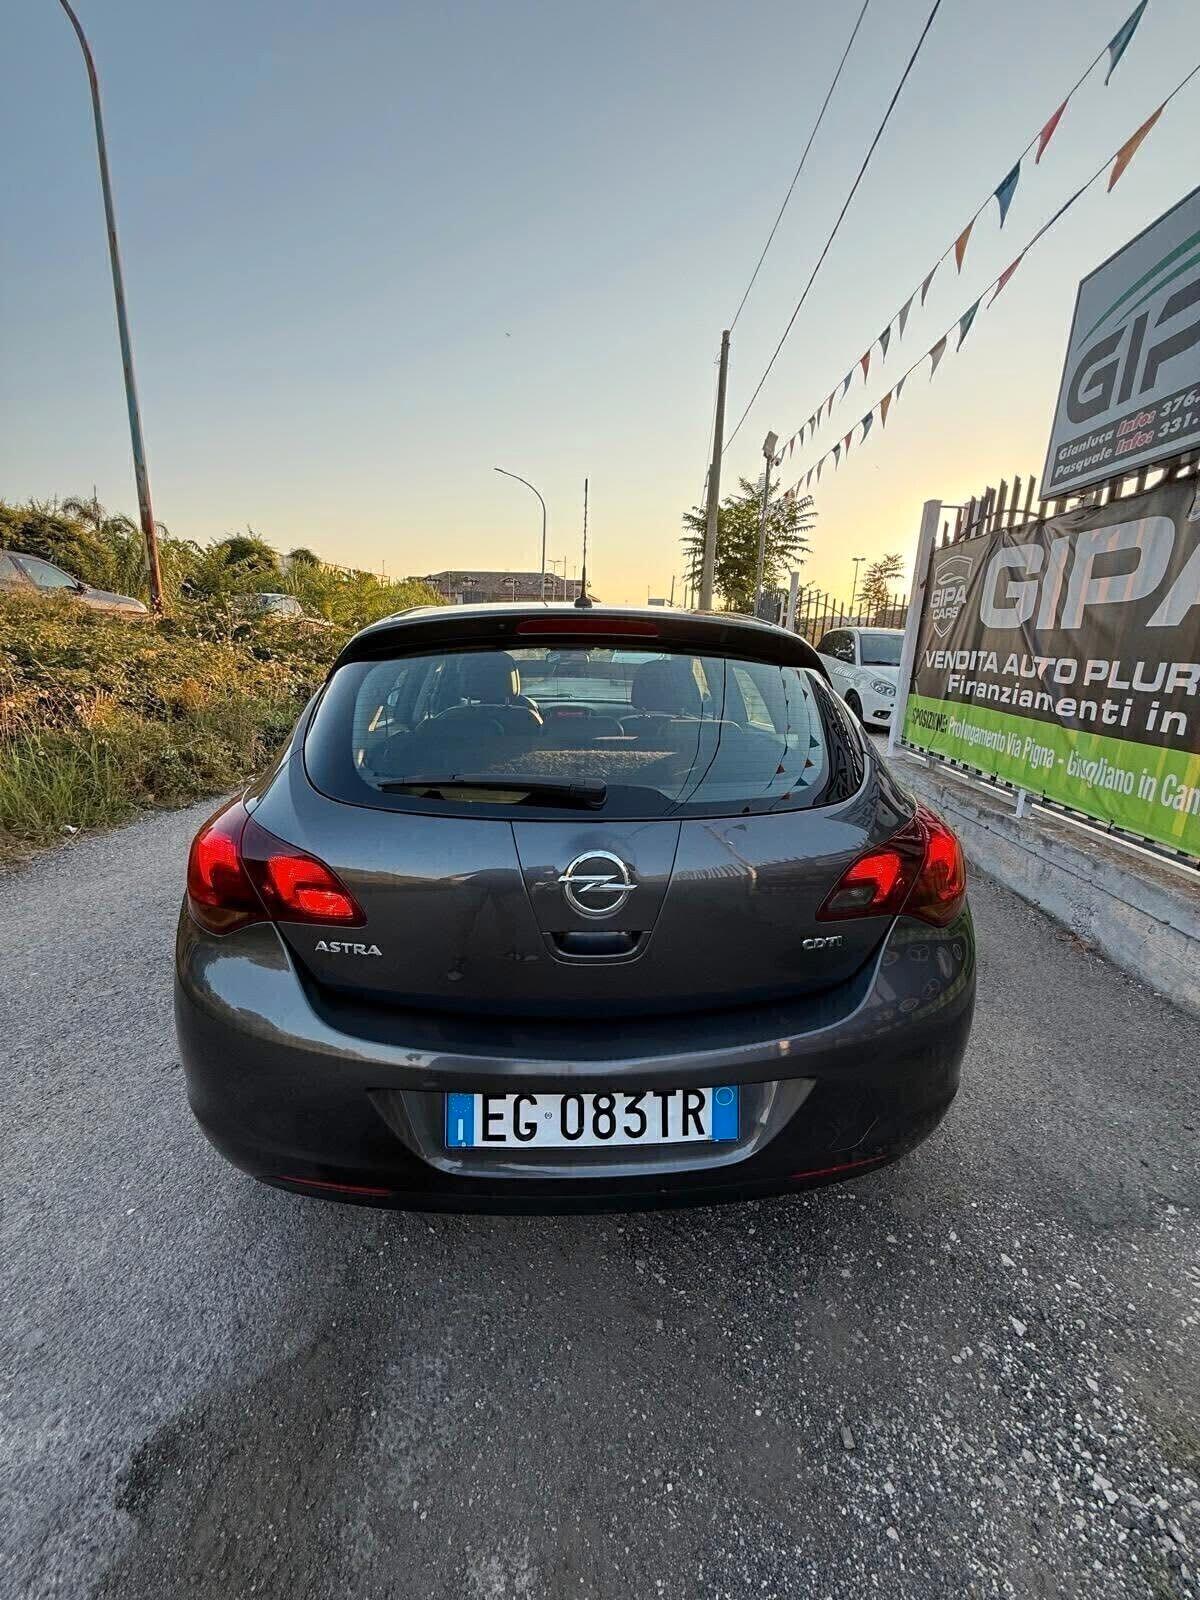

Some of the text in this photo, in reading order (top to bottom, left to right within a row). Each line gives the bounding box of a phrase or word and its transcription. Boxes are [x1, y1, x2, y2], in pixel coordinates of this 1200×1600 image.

[1055, 446, 1113, 478] Pasquale
[1114, 430, 1155, 456] Info:
[1058, 429, 1115, 460] Gianluca
[1116, 410, 1157, 438] Info:
[930, 584, 967, 608] GIPA
[932, 606, 959, 620] CARS
[925, 650, 998, 674] VENDITA
[1002, 653, 1078, 685] AUTO
[947, 674, 1188, 736] Finanziamenti in
[1006, 732, 1022, 758] Via
[1022, 736, 1055, 769] Pigna
[1137, 768, 1157, 802] in
[315, 940, 383, 956] ASTRA
[802, 935, 843, 950] CDTI
[481, 1092, 538, 1142] EG
